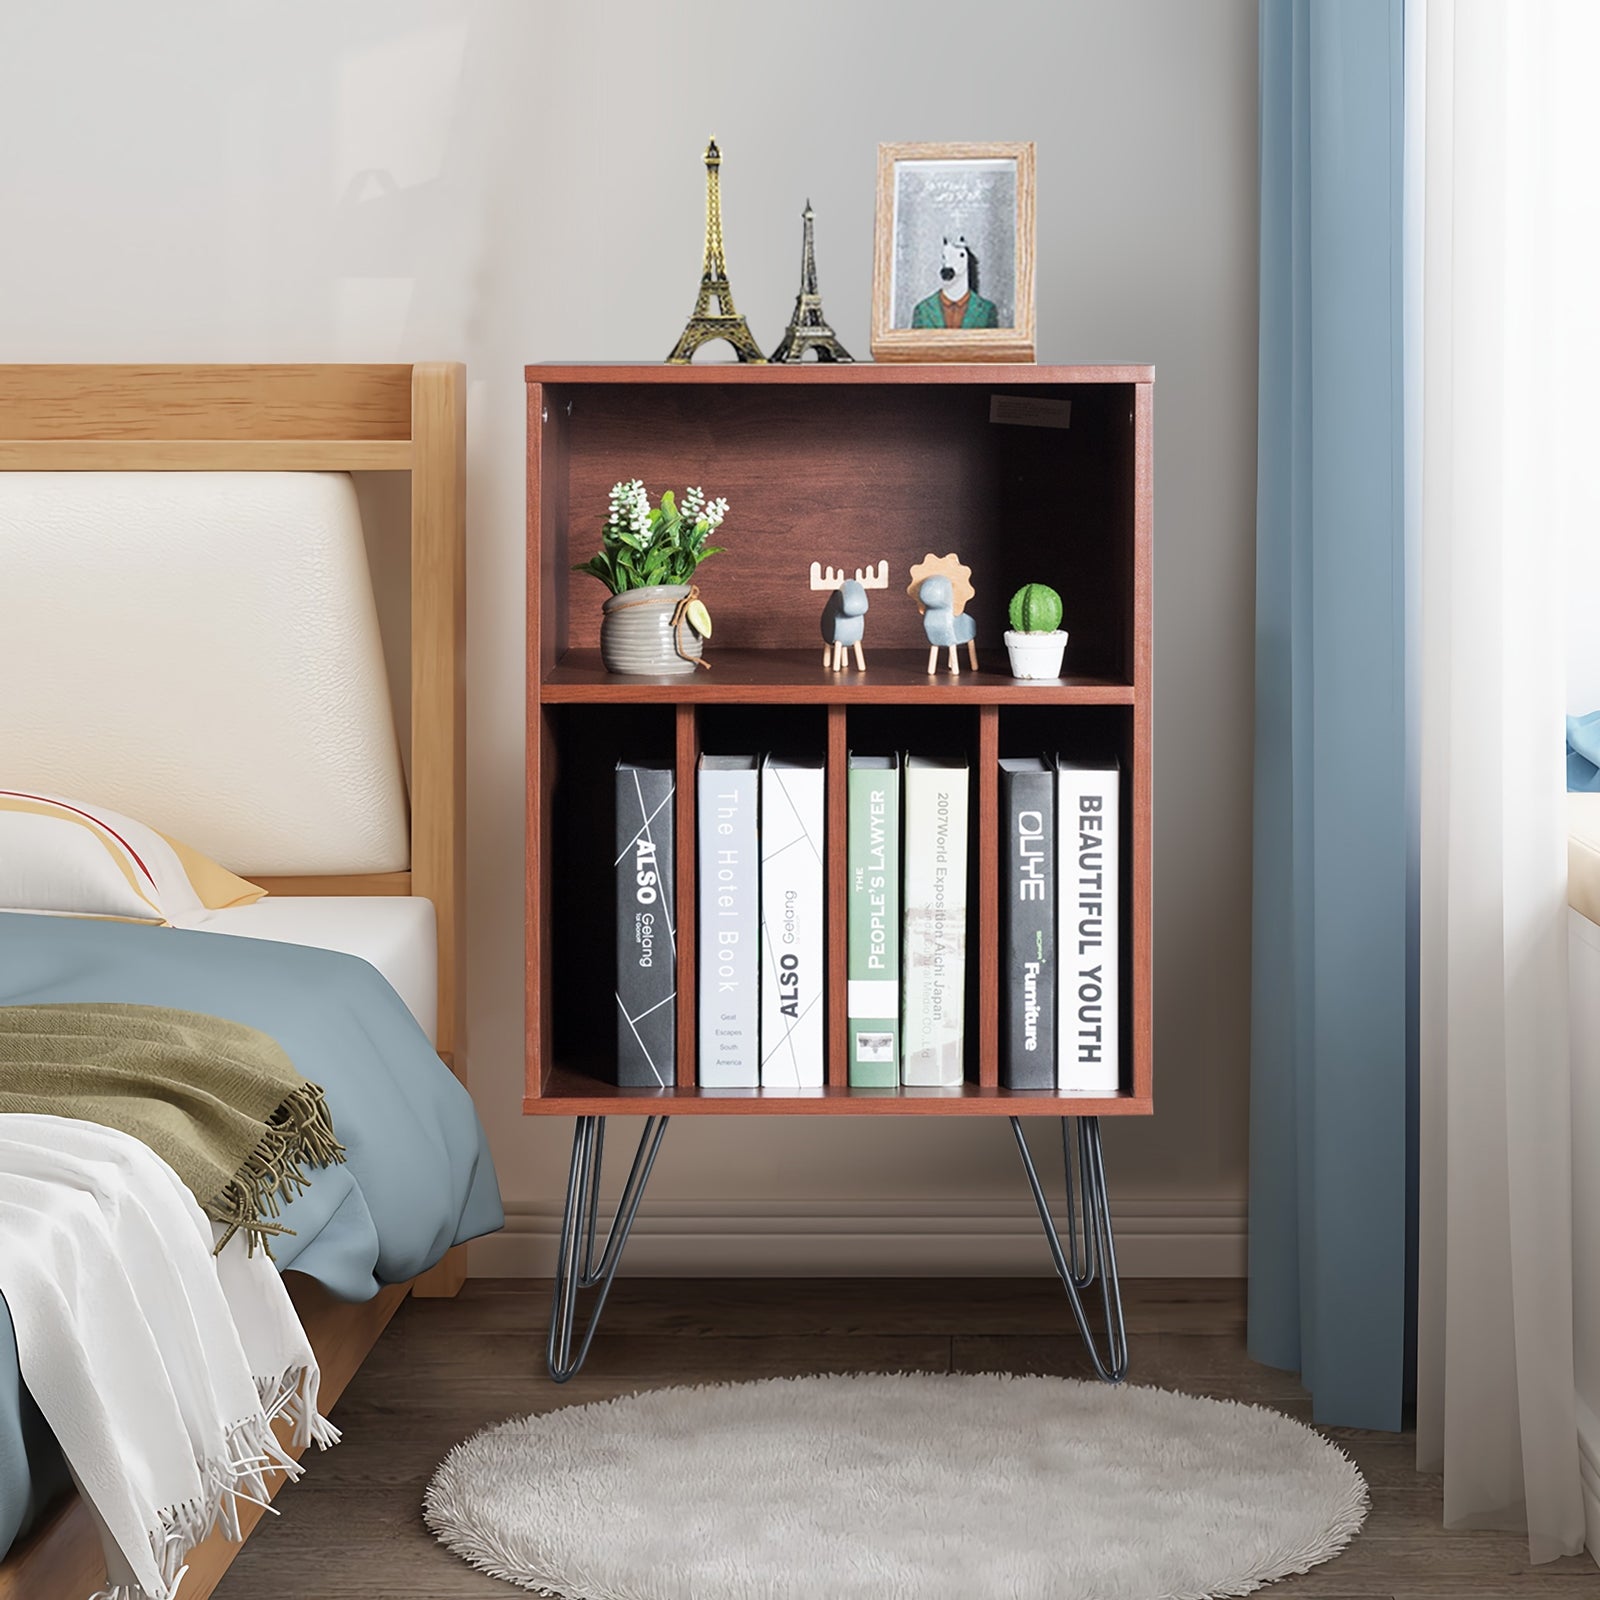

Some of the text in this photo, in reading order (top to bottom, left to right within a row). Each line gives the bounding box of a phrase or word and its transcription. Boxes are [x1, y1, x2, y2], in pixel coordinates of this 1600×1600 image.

[636, 838, 657, 967] ALSO Gelang
[716, 789, 739, 993] The Hotel Book
[855, 866, 864, 892] THE
[868, 789, 885, 969] PEOPLE'S LAWYER
[932, 792, 949, 1021] 2007World Exposition Aichi Japan
[1078, 795, 1103, 1063] BEAUTIFUL YOUTH
[780, 890, 799, 1018] ALSO Gelang
[714, 1029, 742, 1037] Escapes
[719, 1043, 738, 1051] South
